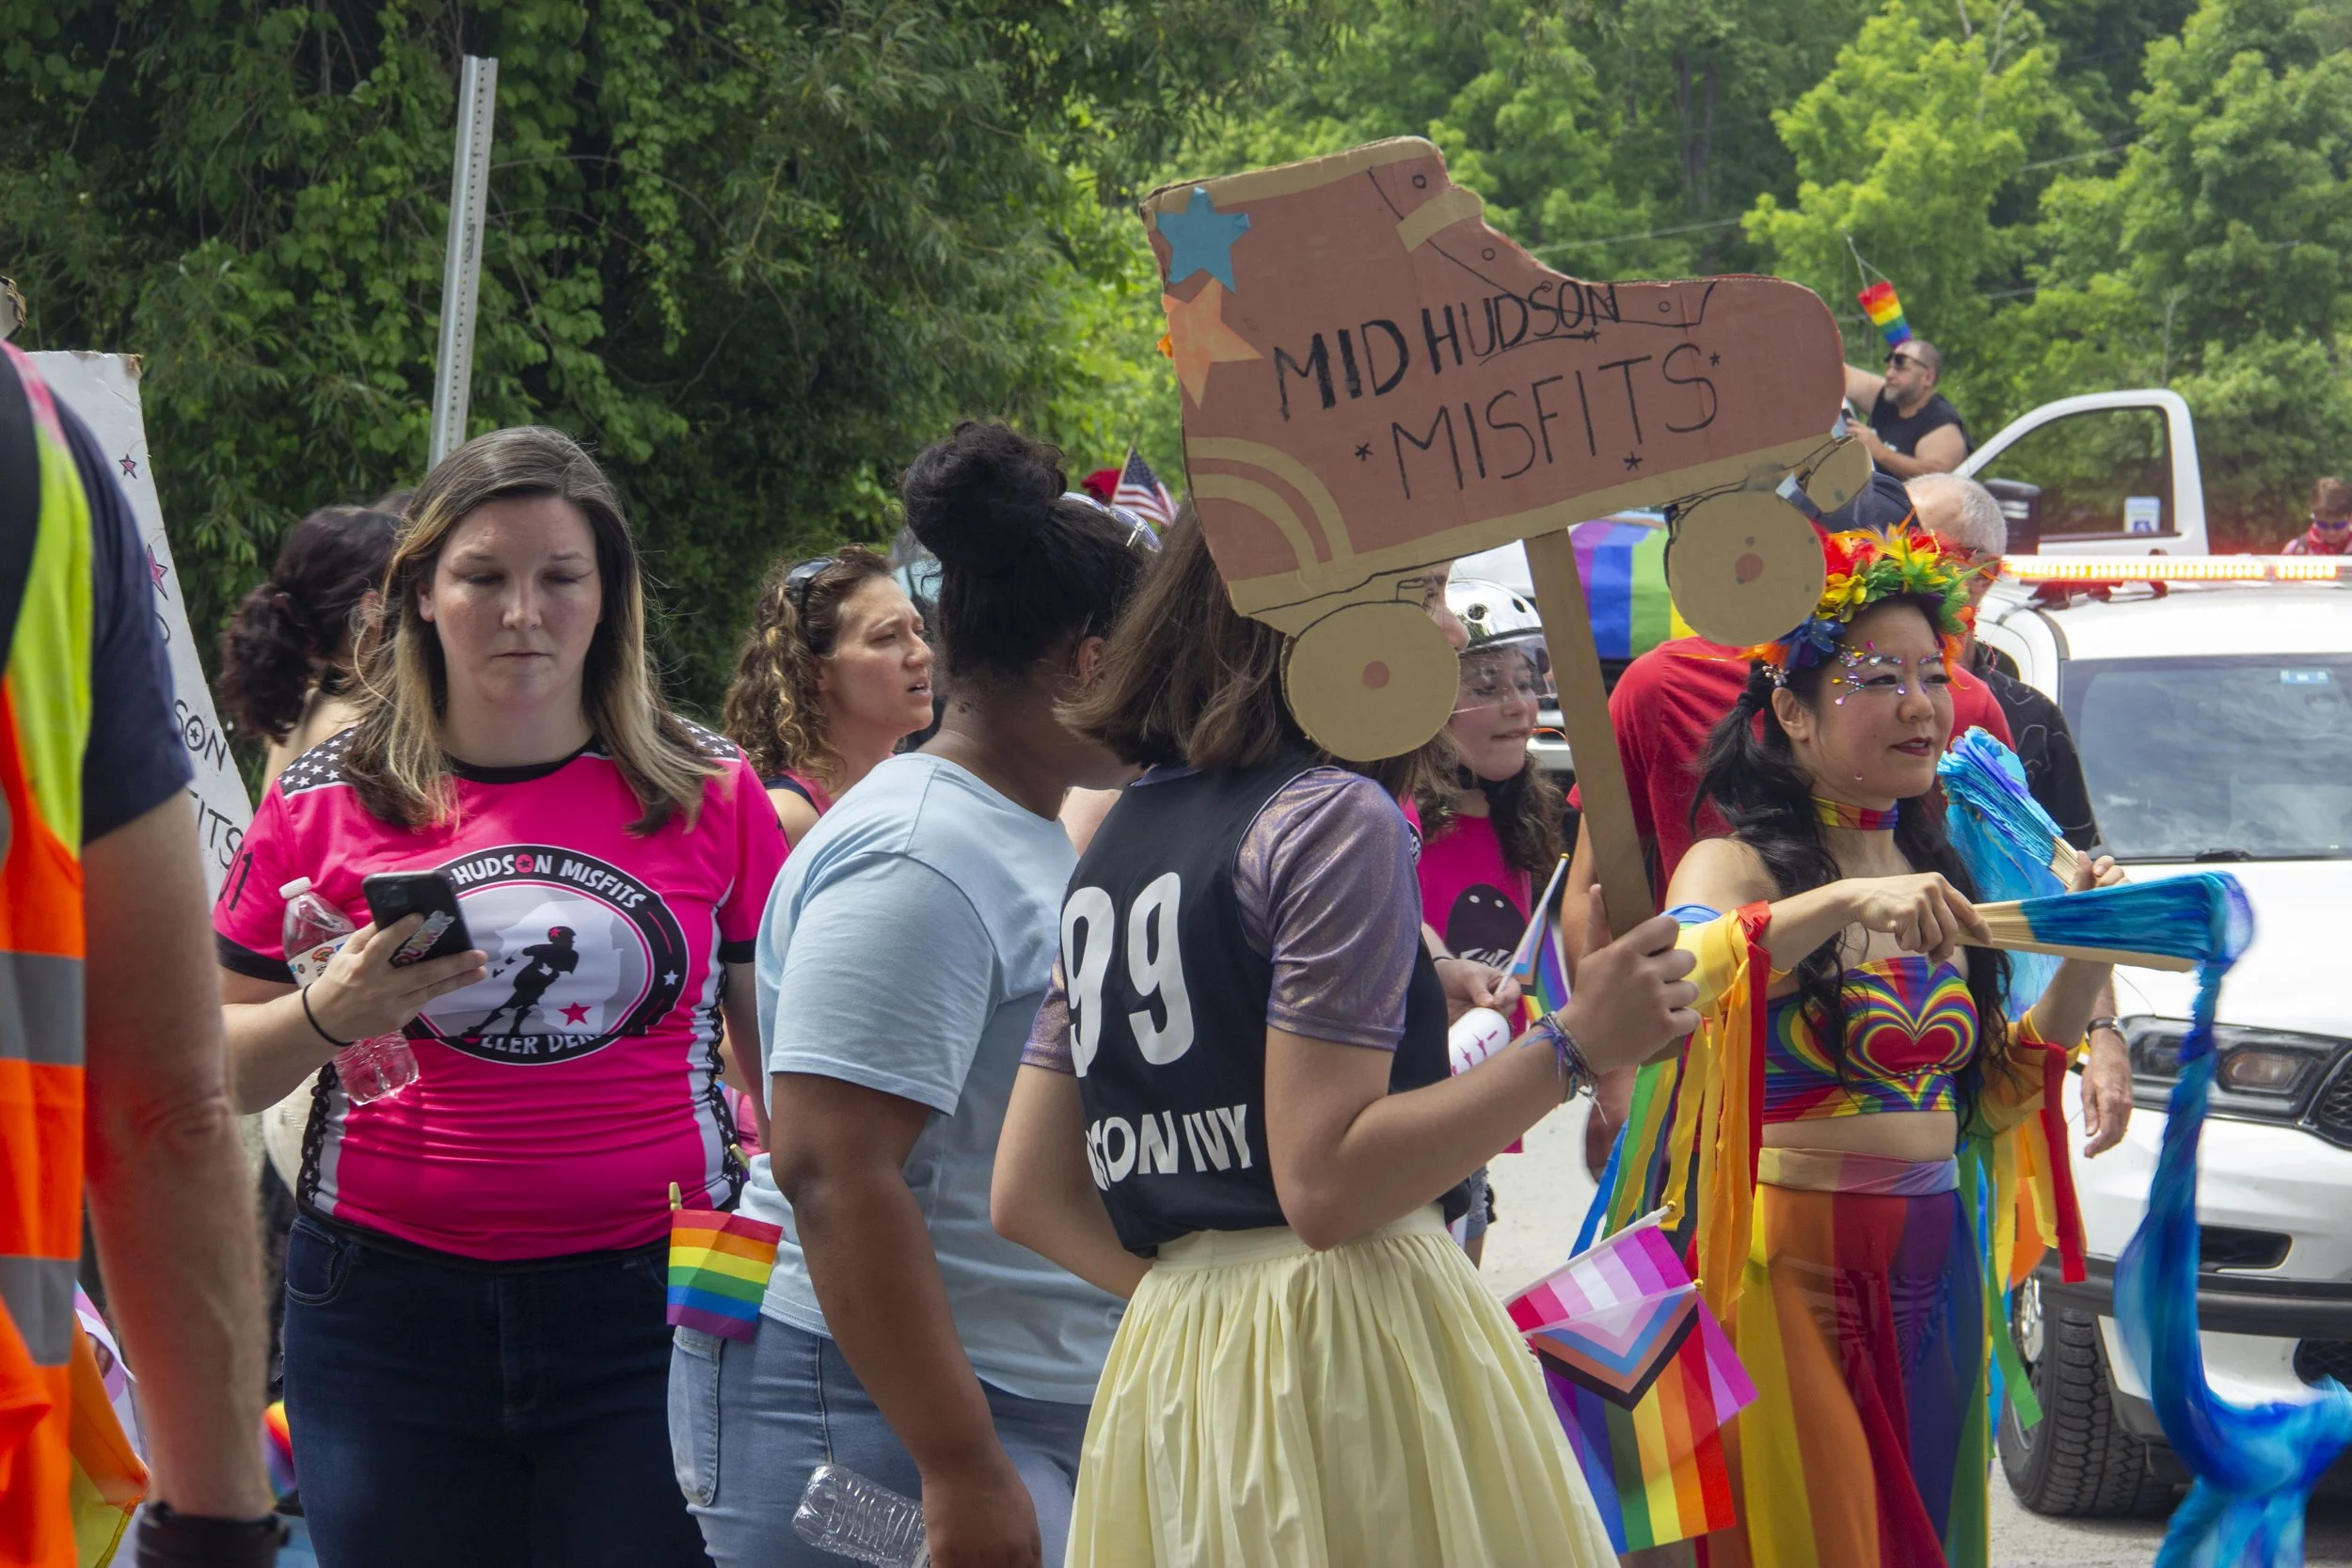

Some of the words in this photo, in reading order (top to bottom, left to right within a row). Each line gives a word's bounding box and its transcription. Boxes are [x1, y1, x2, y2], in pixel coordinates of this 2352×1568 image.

[1273, 318, 1409, 421] MID
[1421, 282, 1619, 374] HUDSON
[1391, 342, 1718, 500] MISFITS
[188, 787, 243, 870] ITS
[559, 859, 646, 909] MISFITS
[1060, 871, 1195, 1078] 99
[1182, 1103, 1254, 1172] IVY
